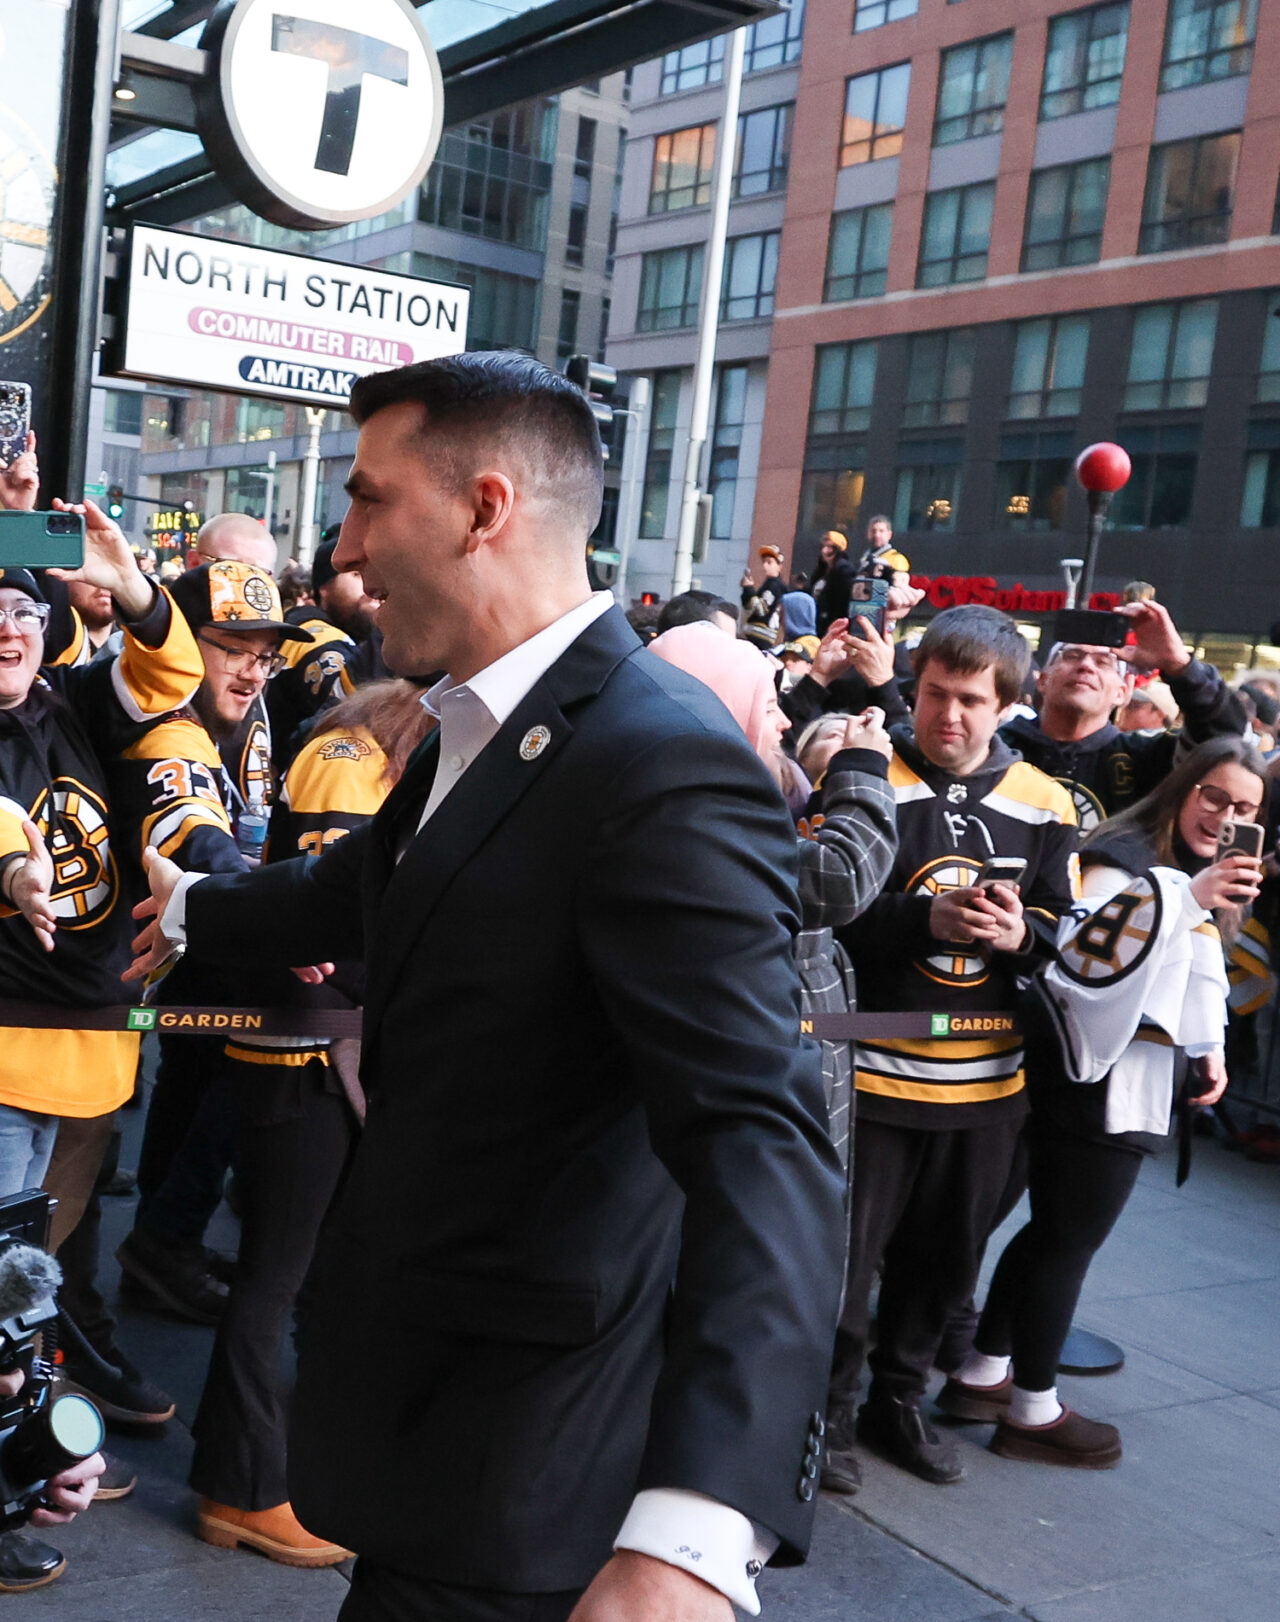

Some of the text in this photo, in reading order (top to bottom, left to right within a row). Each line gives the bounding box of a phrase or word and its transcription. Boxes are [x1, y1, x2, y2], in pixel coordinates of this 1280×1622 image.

[270, 13, 409, 176] T
[143, 242, 458, 333] NORTH STATION
[197, 309, 408, 365] COMMUTER RAIL
[247, 357, 355, 396] AMTRAK
[929, 575, 998, 608] CVS
[132, 1012, 262, 1028] TD GARDEN
[933, 1017, 1014, 1032] TD GARDEN
